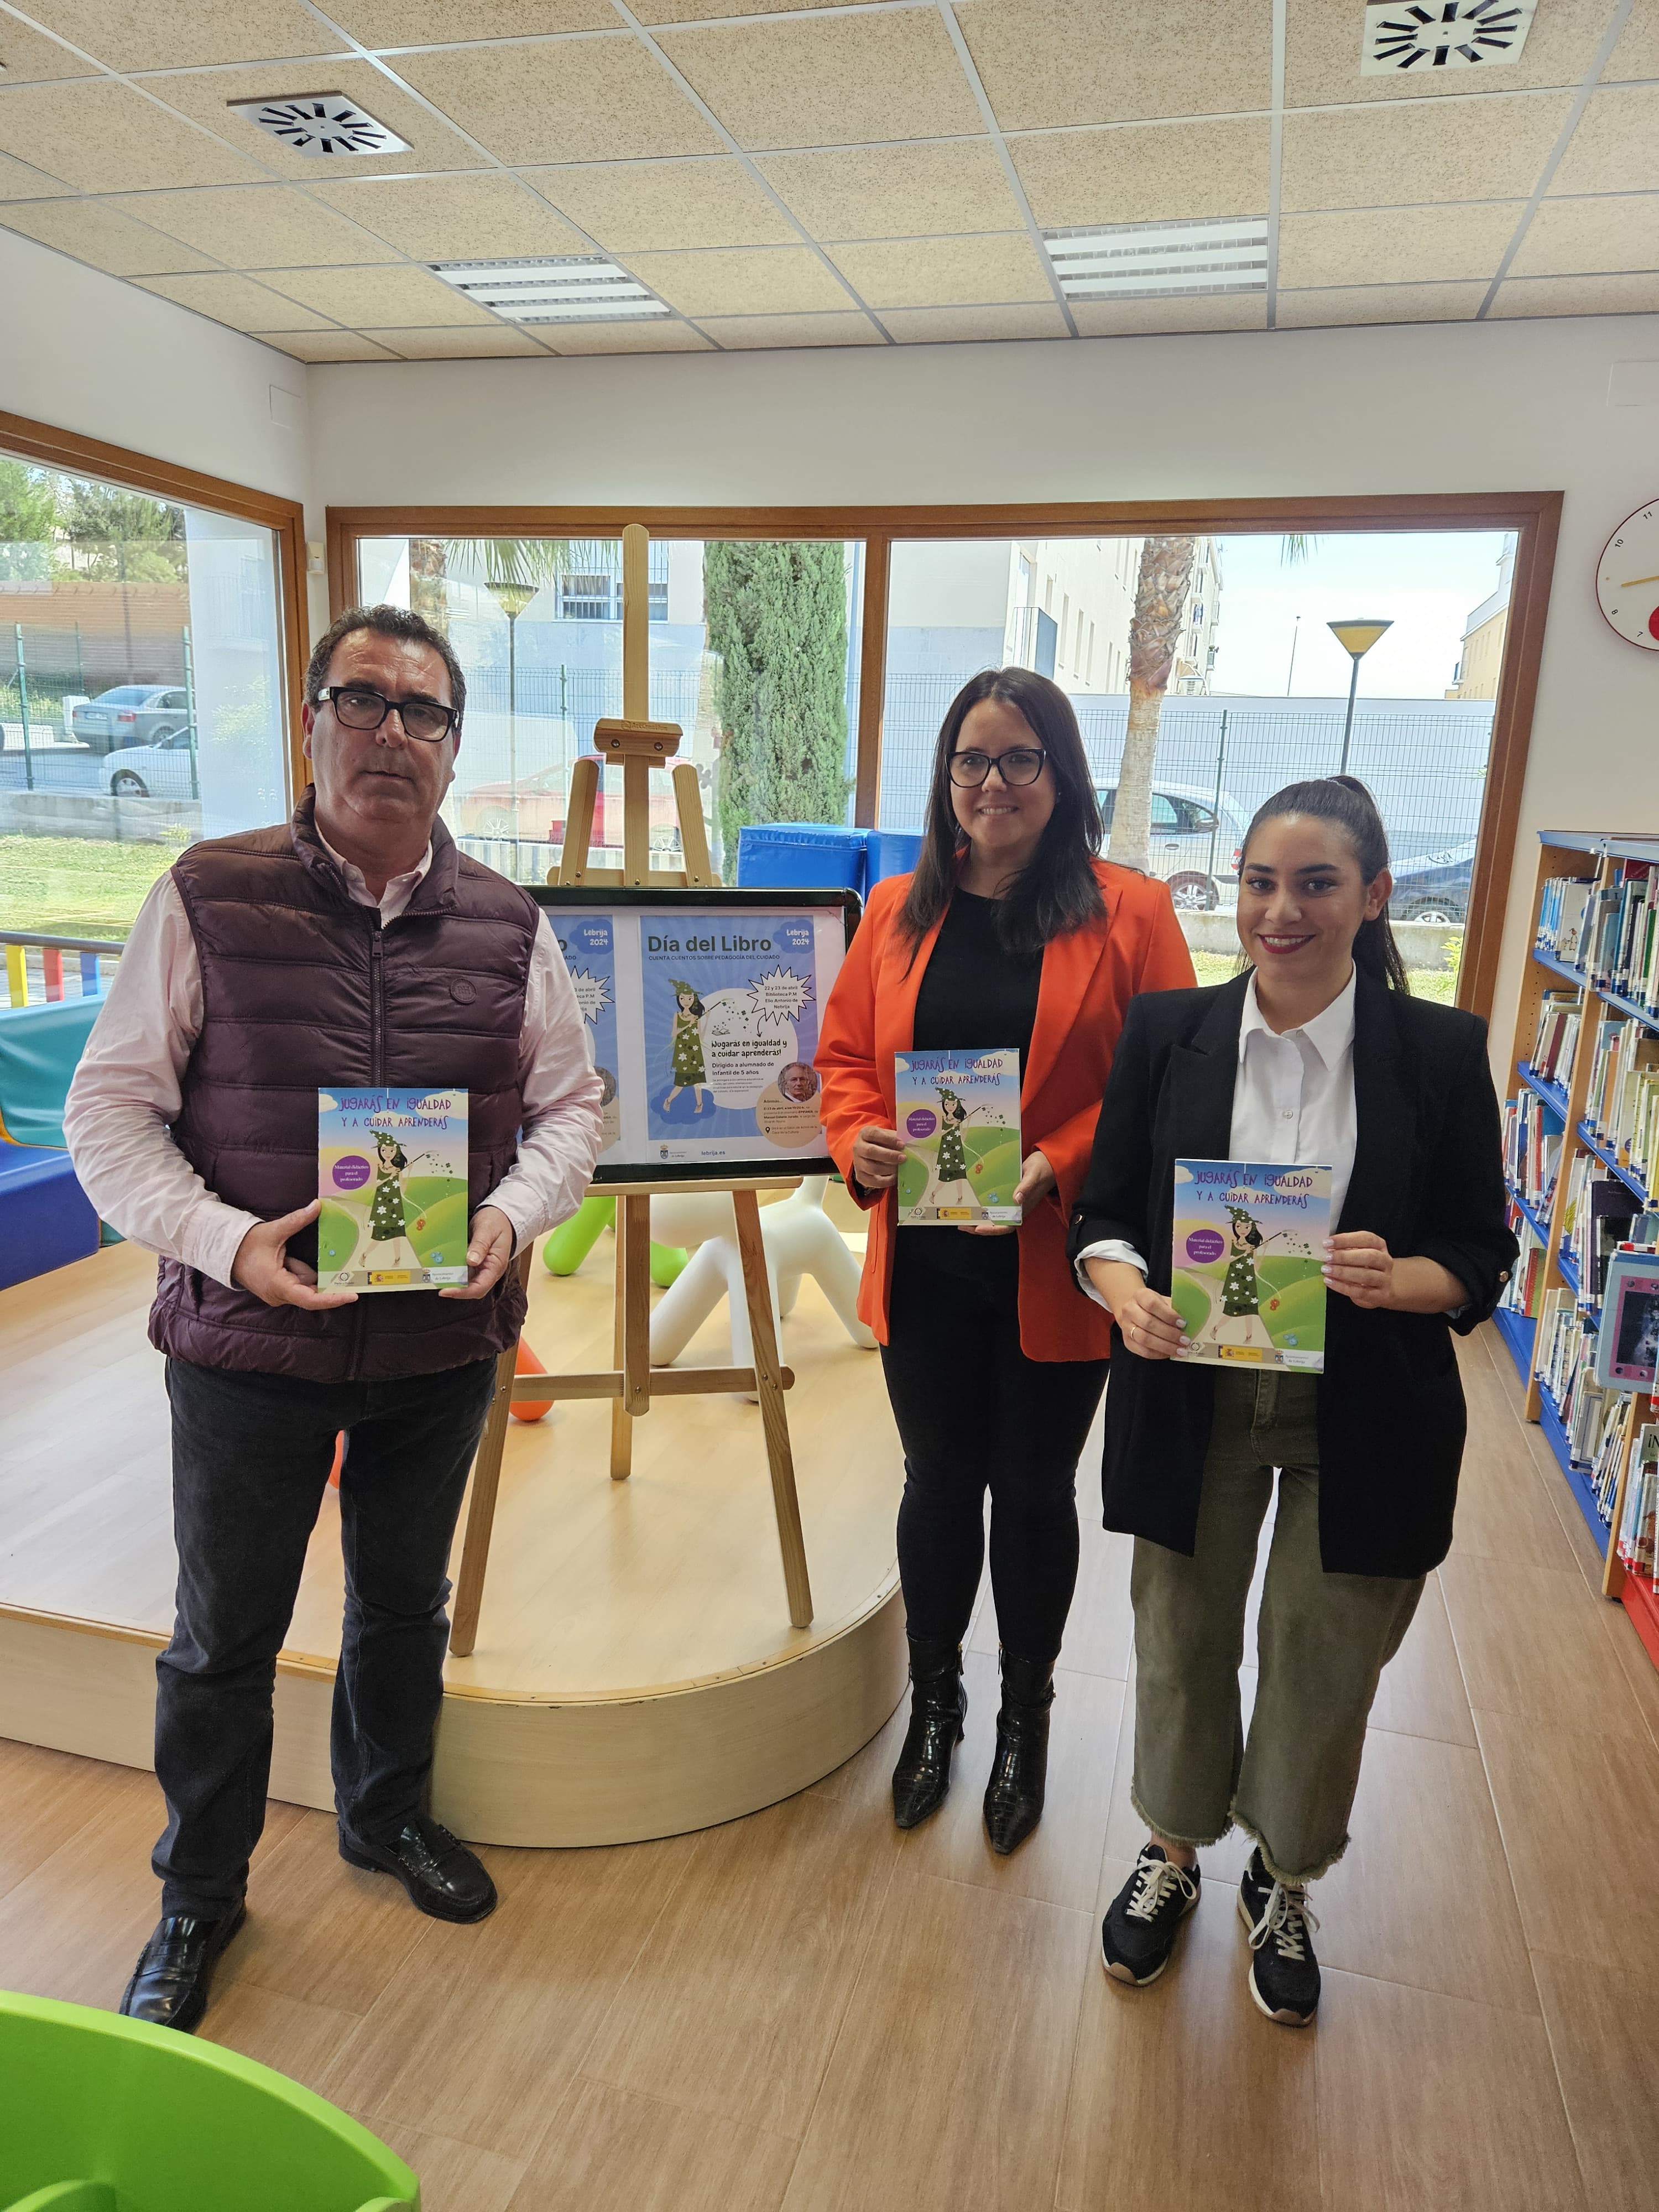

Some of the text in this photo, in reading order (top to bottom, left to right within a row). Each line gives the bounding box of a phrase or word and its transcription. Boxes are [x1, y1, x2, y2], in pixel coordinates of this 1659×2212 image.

[1643, 512, 1653, 520] 11
[1615, 539, 1624, 548] 10
[583, 928, 608, 937] Lebrija
[786, 929, 809, 938] Lebrija
[648, 935, 771, 952] Día del Libro
[752, 1039, 781, 1049] igualdad
[741, 1049, 781, 1058] aprenderás!
[948, 1059, 959, 1070] EN
[958, 1073, 1001, 1086] APRENDERÁS
[387, 1098, 399, 1110] EN
[342, 1117, 347, 1127] Y
[352, 1117, 358, 1127] A
[398, 1115, 448, 1130] APRENDERÁS
[1243, 1173, 1257, 1186] EN
[1197, 1190, 1202, 1201] Y
[1207, 1191, 1213, 1201] A
[1254, 1193, 1309, 1209] APRENDERÁS
